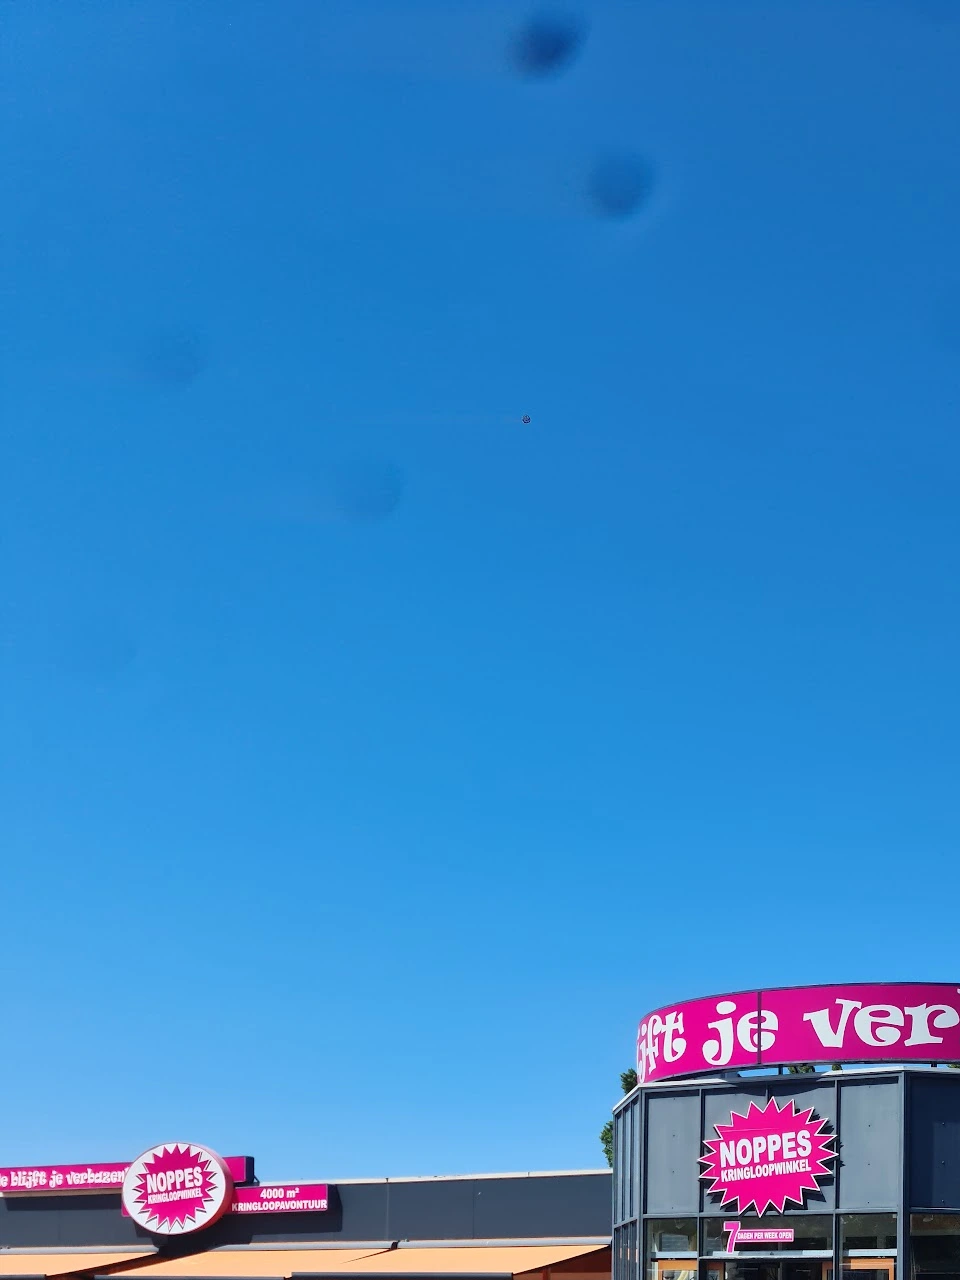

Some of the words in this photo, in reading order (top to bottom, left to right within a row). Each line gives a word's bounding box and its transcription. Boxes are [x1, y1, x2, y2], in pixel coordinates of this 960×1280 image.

[702, 1001, 778, 1065] je
[720, 1129, 812, 1168] NOPPES
[0, 1172, 8, 1187] e
[10, 1170, 46, 1188] blijft
[49, 1170, 63, 1188] je
[146, 1166, 203, 1193] NOPPES
[721, 1159, 812, 1182] KRINGLOOPWINKEL
[147, 1187, 203, 1204] KRINGLOOPWINKEL
[260, 1188, 284, 1199] 4000
[232, 1199, 327, 1212] KRINGLOOPAVONTUUR
[723, 1221, 741, 1254] 7
[737, 1231, 753, 1239] DAGEN
[754, 1231, 764, 1239] PER
[764, 1231, 778, 1239] WEEK
[779, 1231, 792, 1239] OPEN
